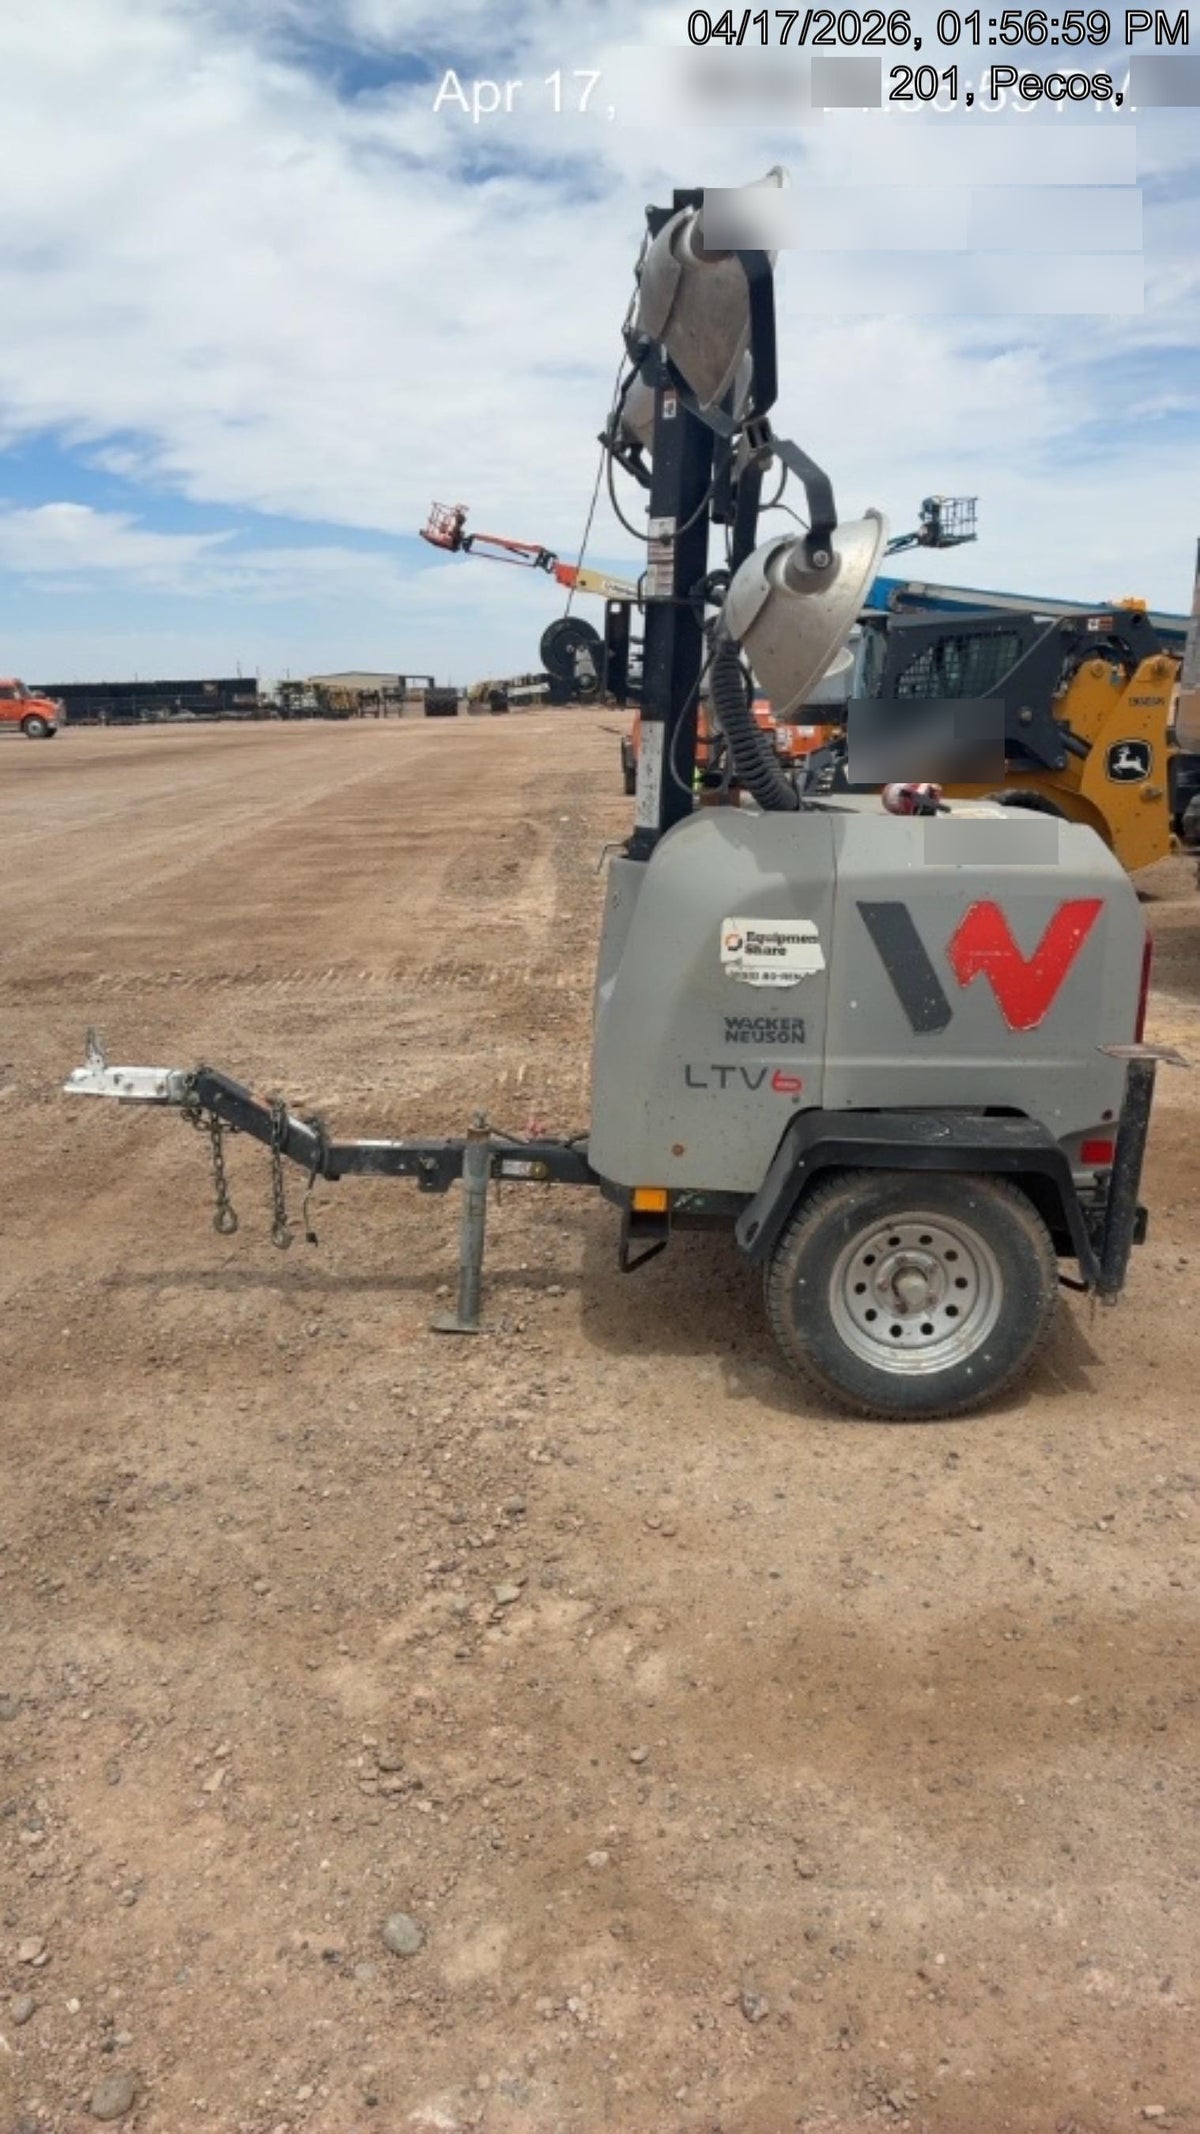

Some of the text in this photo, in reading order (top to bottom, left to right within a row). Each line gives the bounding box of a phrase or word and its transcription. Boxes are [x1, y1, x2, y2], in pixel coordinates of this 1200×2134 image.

[744, 944, 787, 956] Share
[724, 1016, 805, 1030] WACKER
[724, 1030, 806, 1044] NEUSON
[685, 1064, 803, 1093] LTV6
